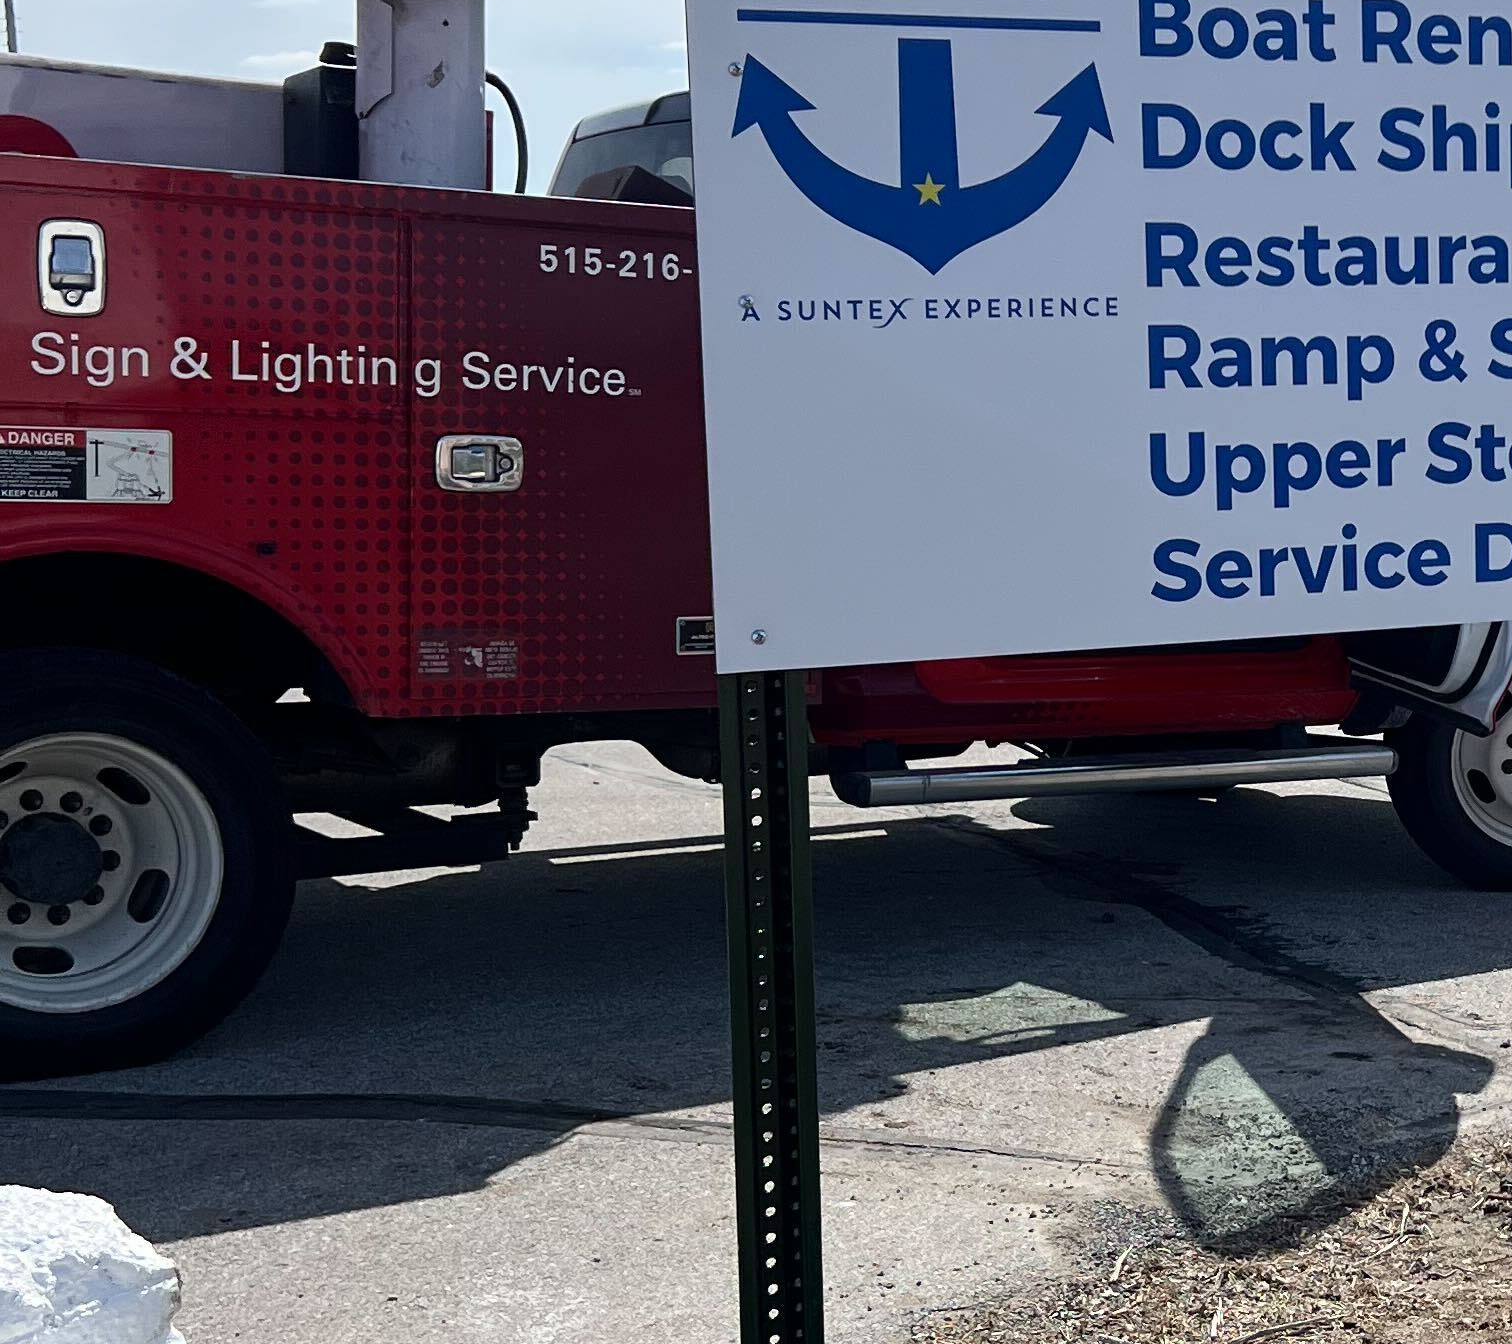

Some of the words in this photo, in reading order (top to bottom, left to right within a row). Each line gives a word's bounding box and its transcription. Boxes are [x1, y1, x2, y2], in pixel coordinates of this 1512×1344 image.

[1141, 102, 1357, 173] Dock
[741, 300, 761, 322] A
[777, 297, 914, 329] SUNTEX
[925, 296, 1118, 320] EXPERIENCE
[30, 331, 150, 388] Sign
[170, 336, 213, 381] &
[231, 339, 442, 398] Lighting
[461, 351, 627, 397] Service
[1147, 324, 1396, 401] Ramp
[1417, 319, 1469, 384] &
[8, 431, 75, 446] DANGER
[1149, 431, 1407, 512] Upper
[1, 489, 26, 497] KEEP
[27, 489, 59, 498] CLEAR
[1151, 522, 1452, 604] Service
